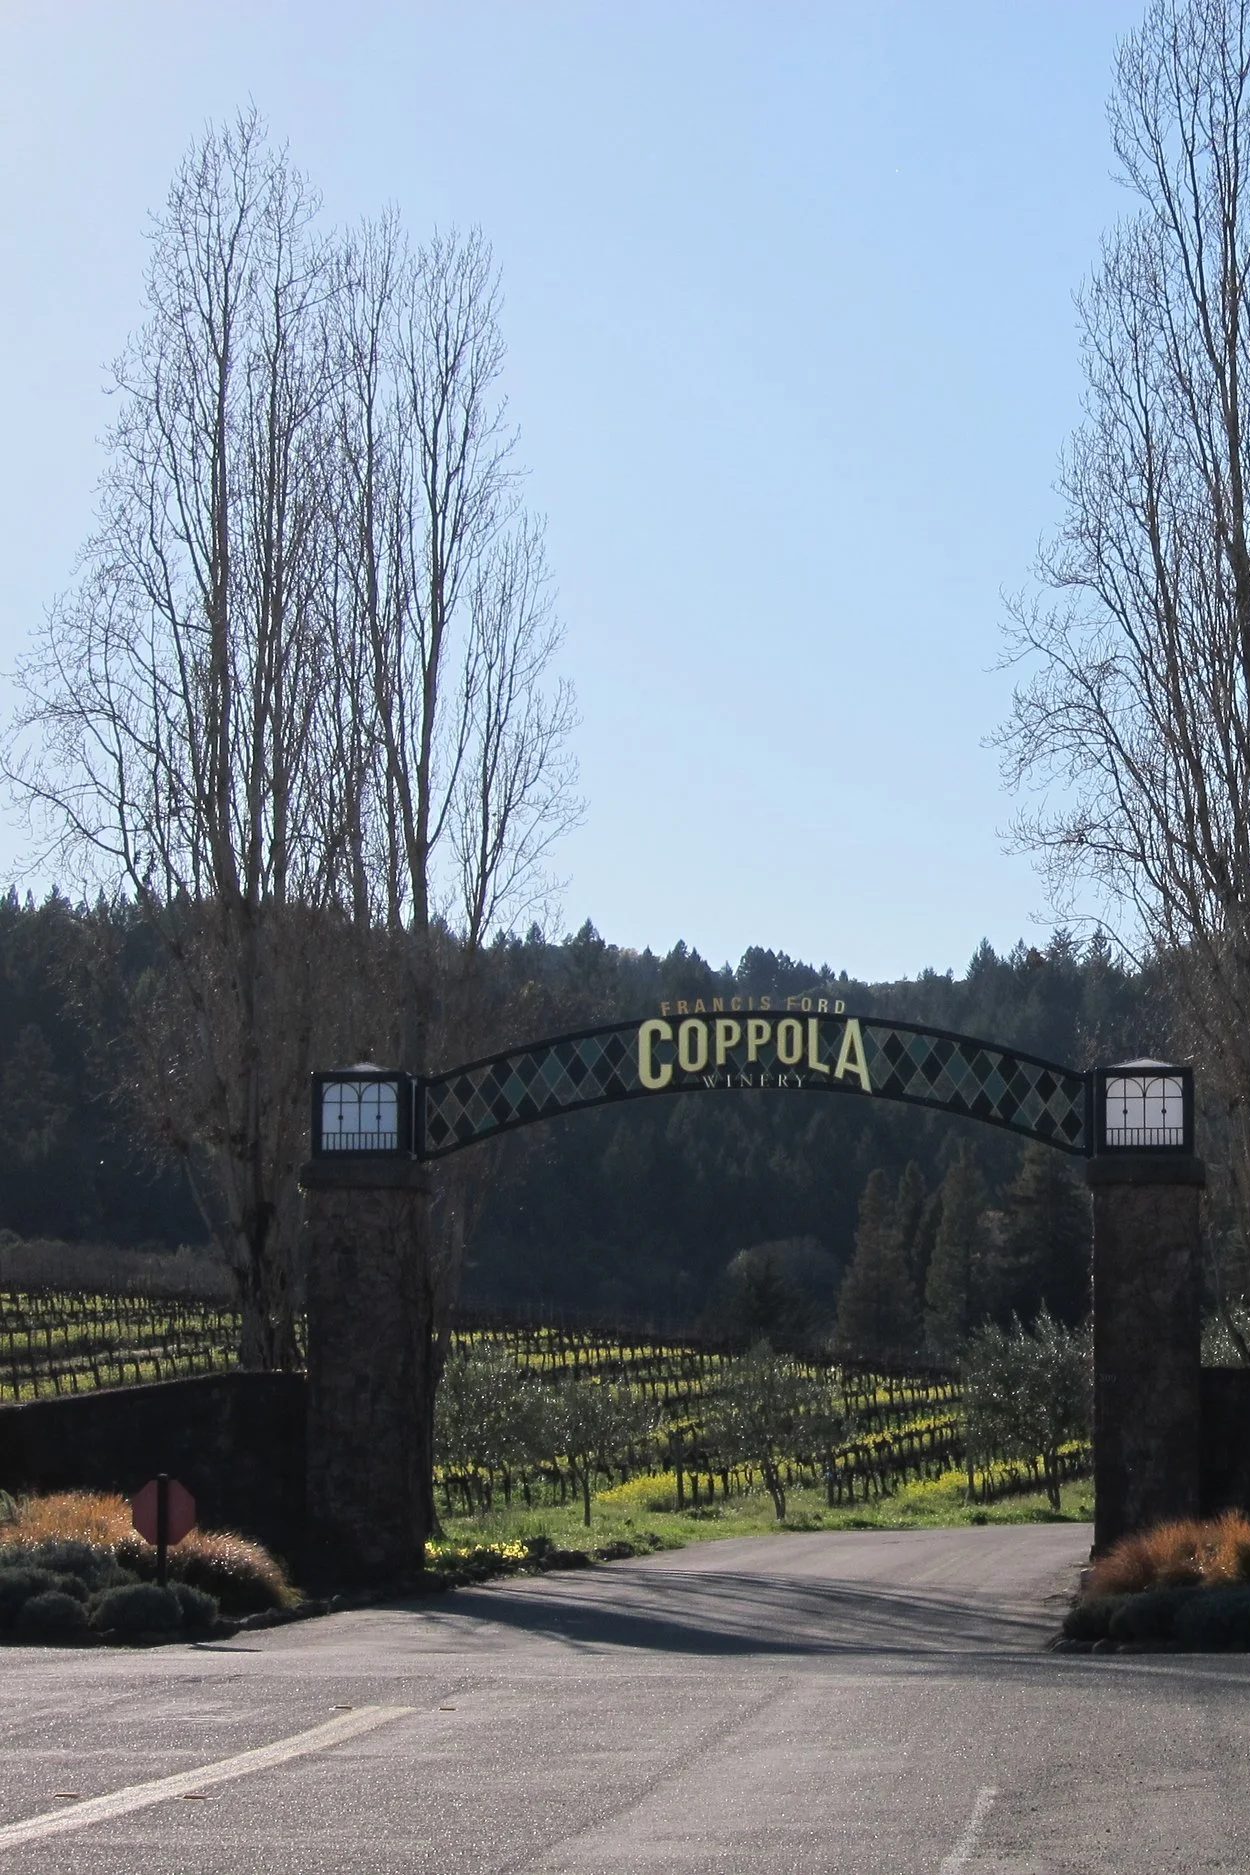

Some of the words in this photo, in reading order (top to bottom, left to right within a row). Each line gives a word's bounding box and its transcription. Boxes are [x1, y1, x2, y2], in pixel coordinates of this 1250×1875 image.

[660, 996, 771, 1017] FRANCIS
[786, 997, 846, 1014] FORD
[638, 1017, 873, 1095] COPPOLA
[702, 1073, 807, 1089] WINERY
